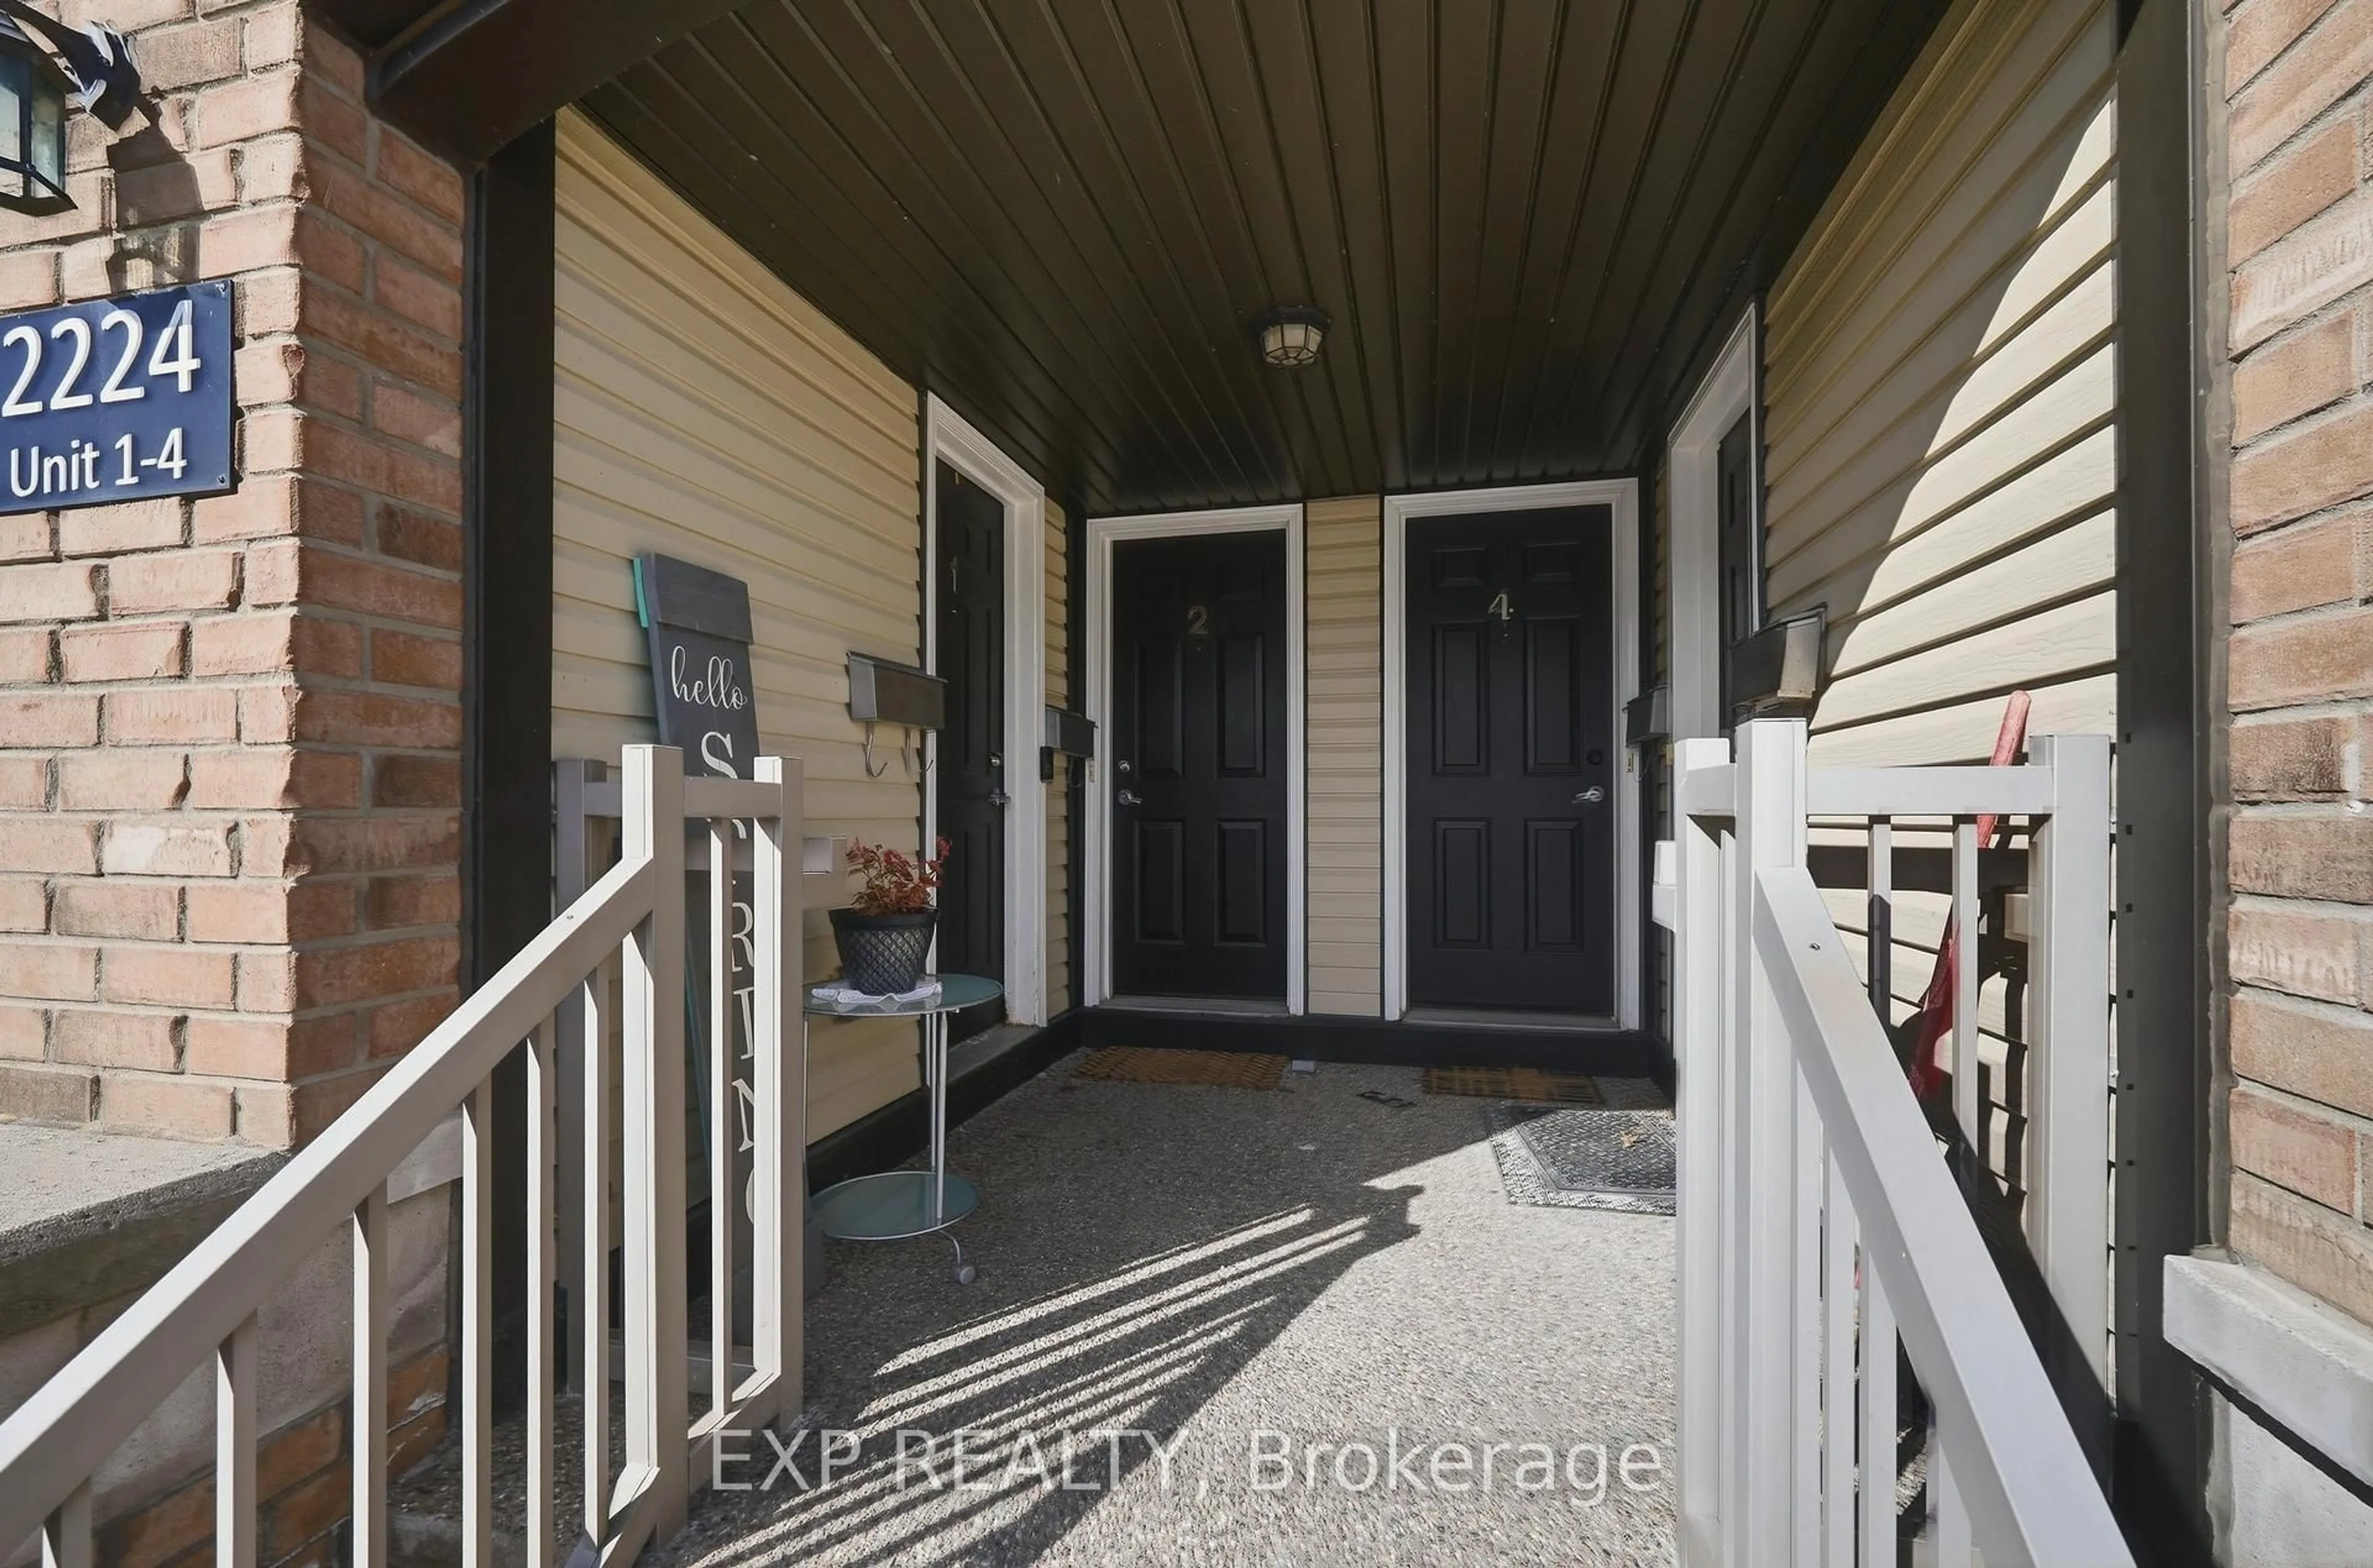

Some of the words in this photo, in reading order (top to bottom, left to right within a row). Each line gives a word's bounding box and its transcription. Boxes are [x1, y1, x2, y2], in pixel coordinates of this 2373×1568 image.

[1, 300, 201, 418] 2224
[10, 437, 100, 498] Unit
[114, 427, 188, 486] 1-4
[1187, 605, 1208, 634] 2
[1487, 591, 1514, 623] 4
[670, 646, 748, 709] hello
